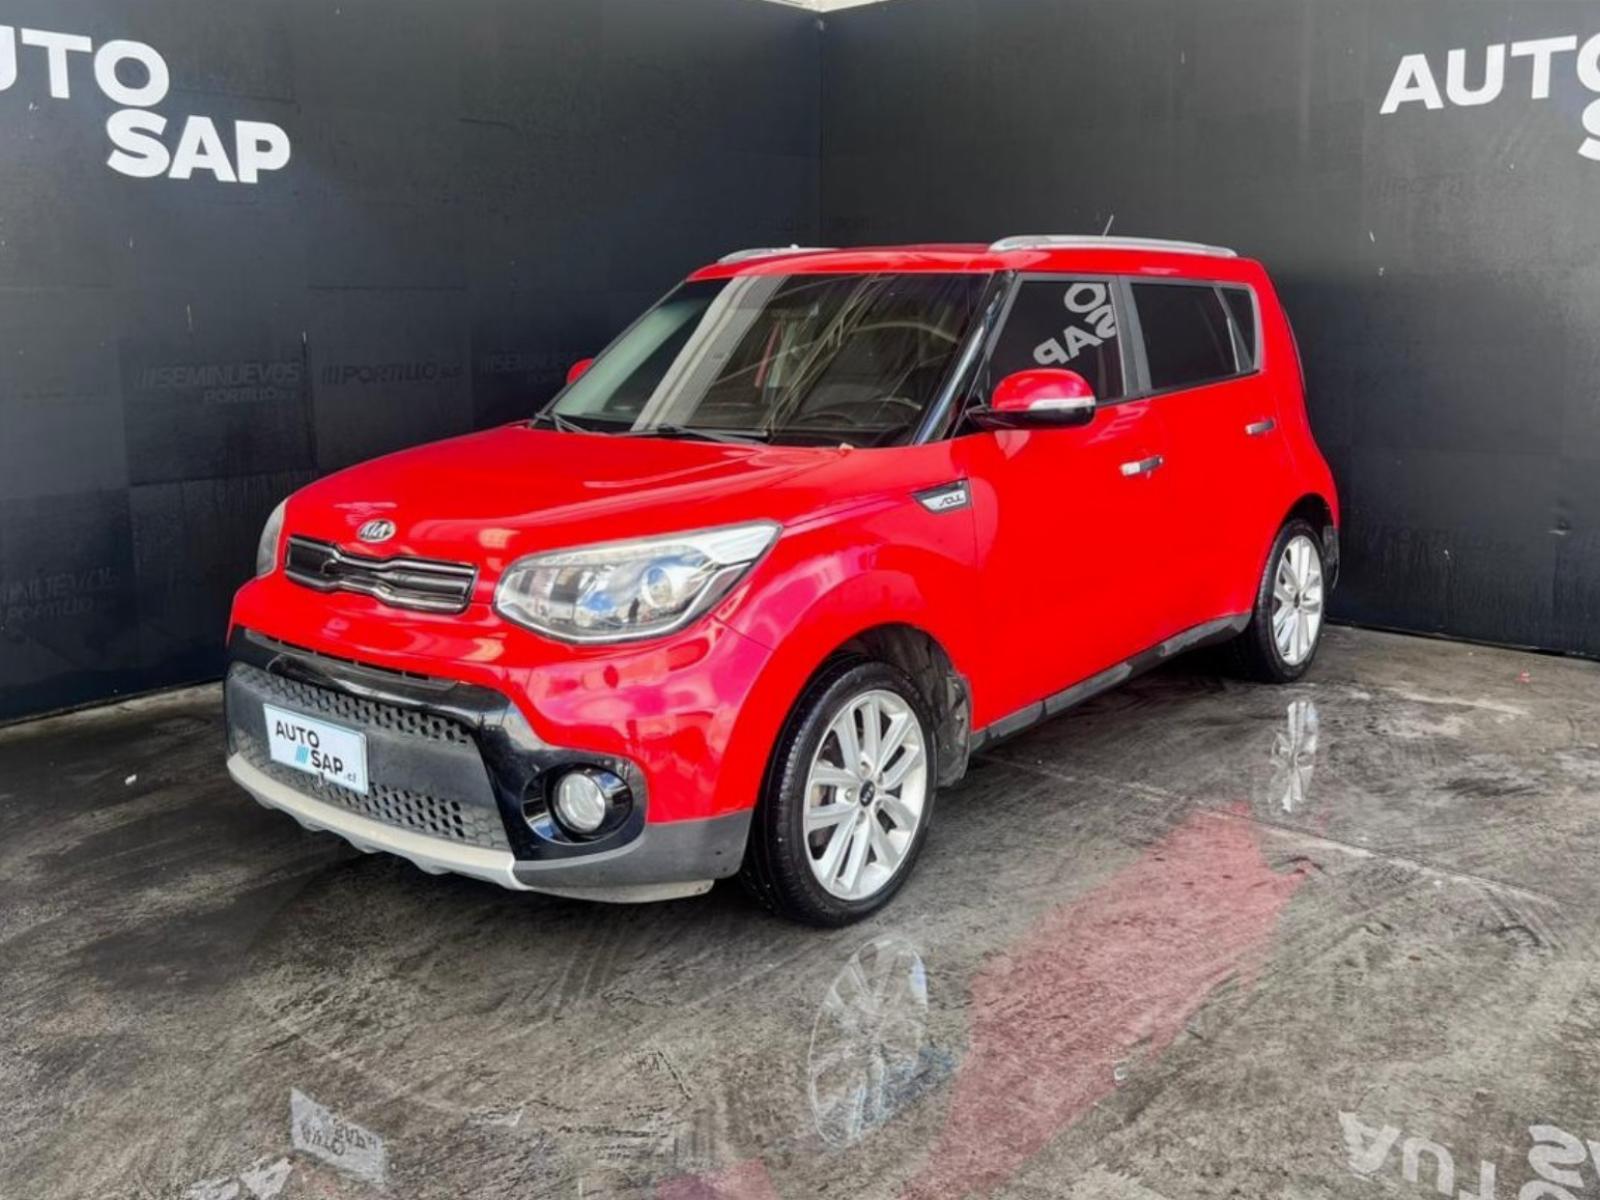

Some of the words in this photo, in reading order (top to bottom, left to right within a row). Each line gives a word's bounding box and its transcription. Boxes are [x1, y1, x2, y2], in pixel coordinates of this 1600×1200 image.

[0, 25, 169, 107] TO
[107, 109, 290, 183] SAP
[275, 720, 319, 749] AUTO
